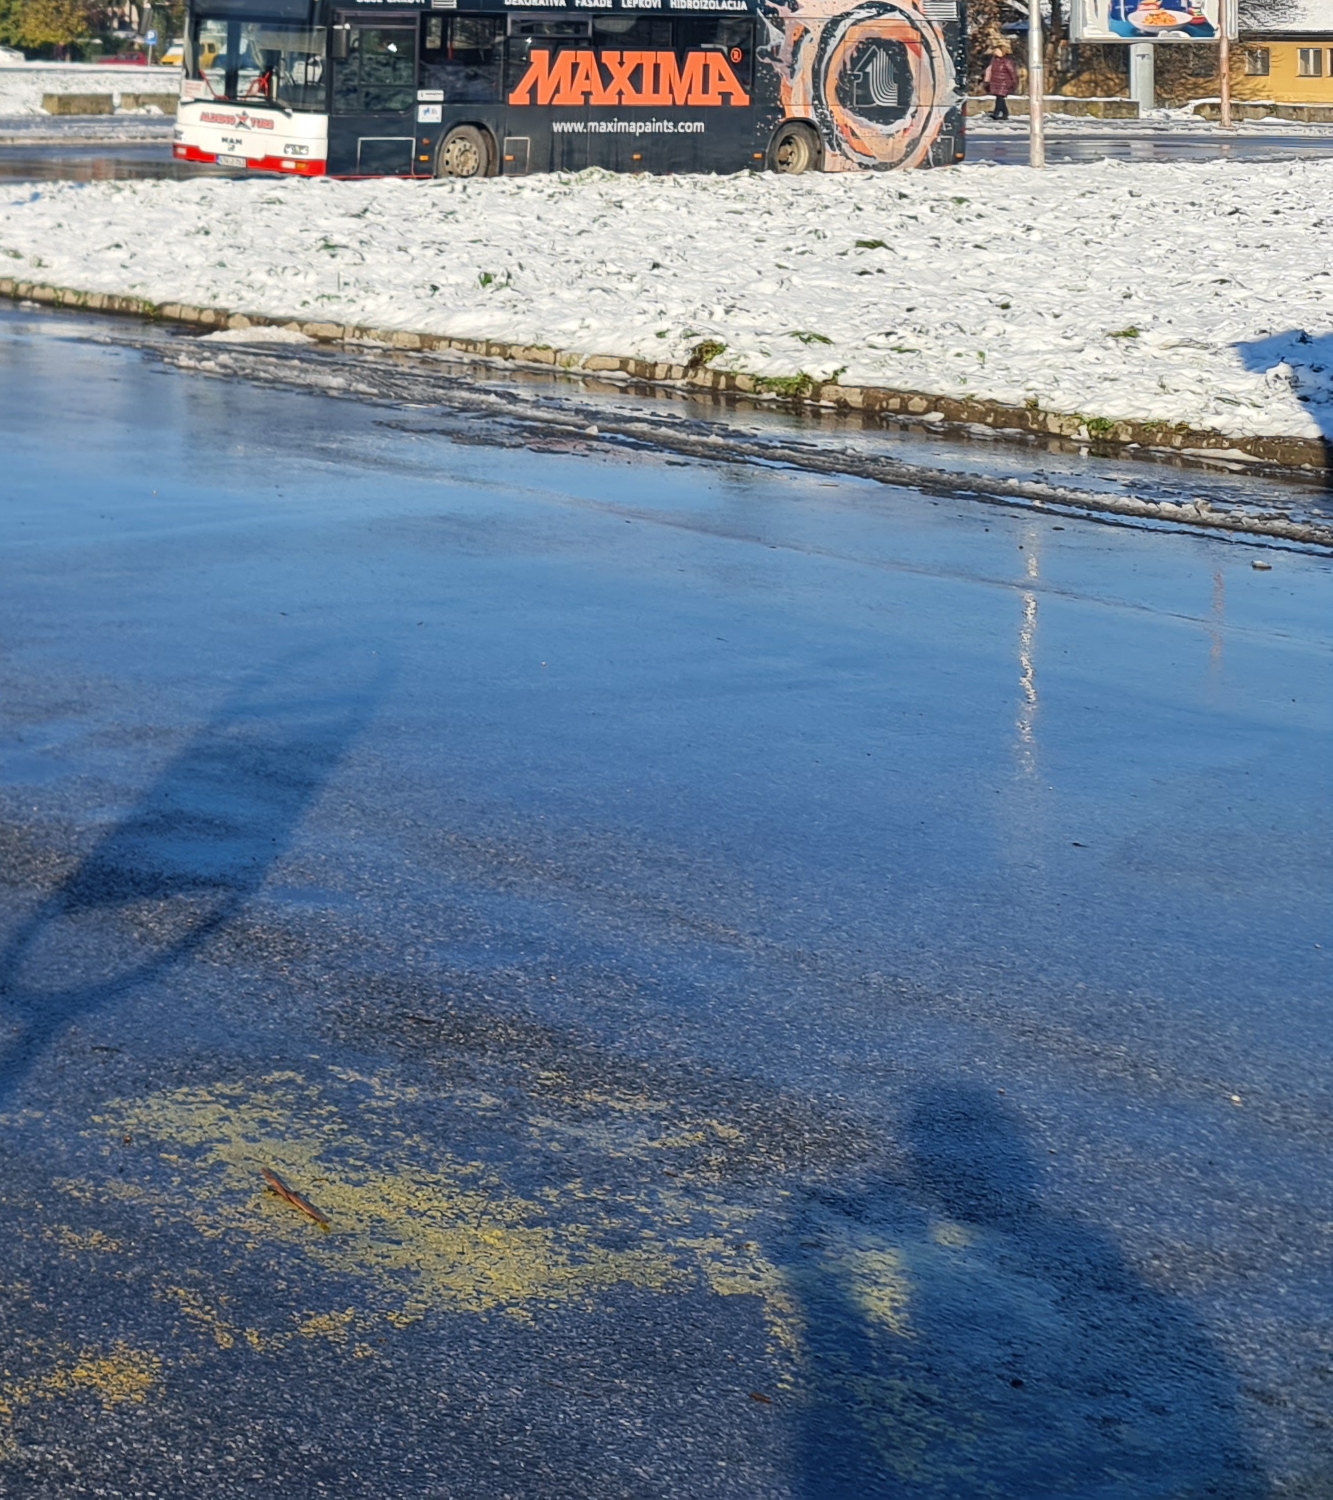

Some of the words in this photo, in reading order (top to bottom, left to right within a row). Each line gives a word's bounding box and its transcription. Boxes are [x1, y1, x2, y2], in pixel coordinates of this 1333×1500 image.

[669, 0, 748, 11] HIDROIZOLACIJA
[509, 49, 750, 106] MAXIMA
[552, 118, 705, 136] www.maximapaints.com
